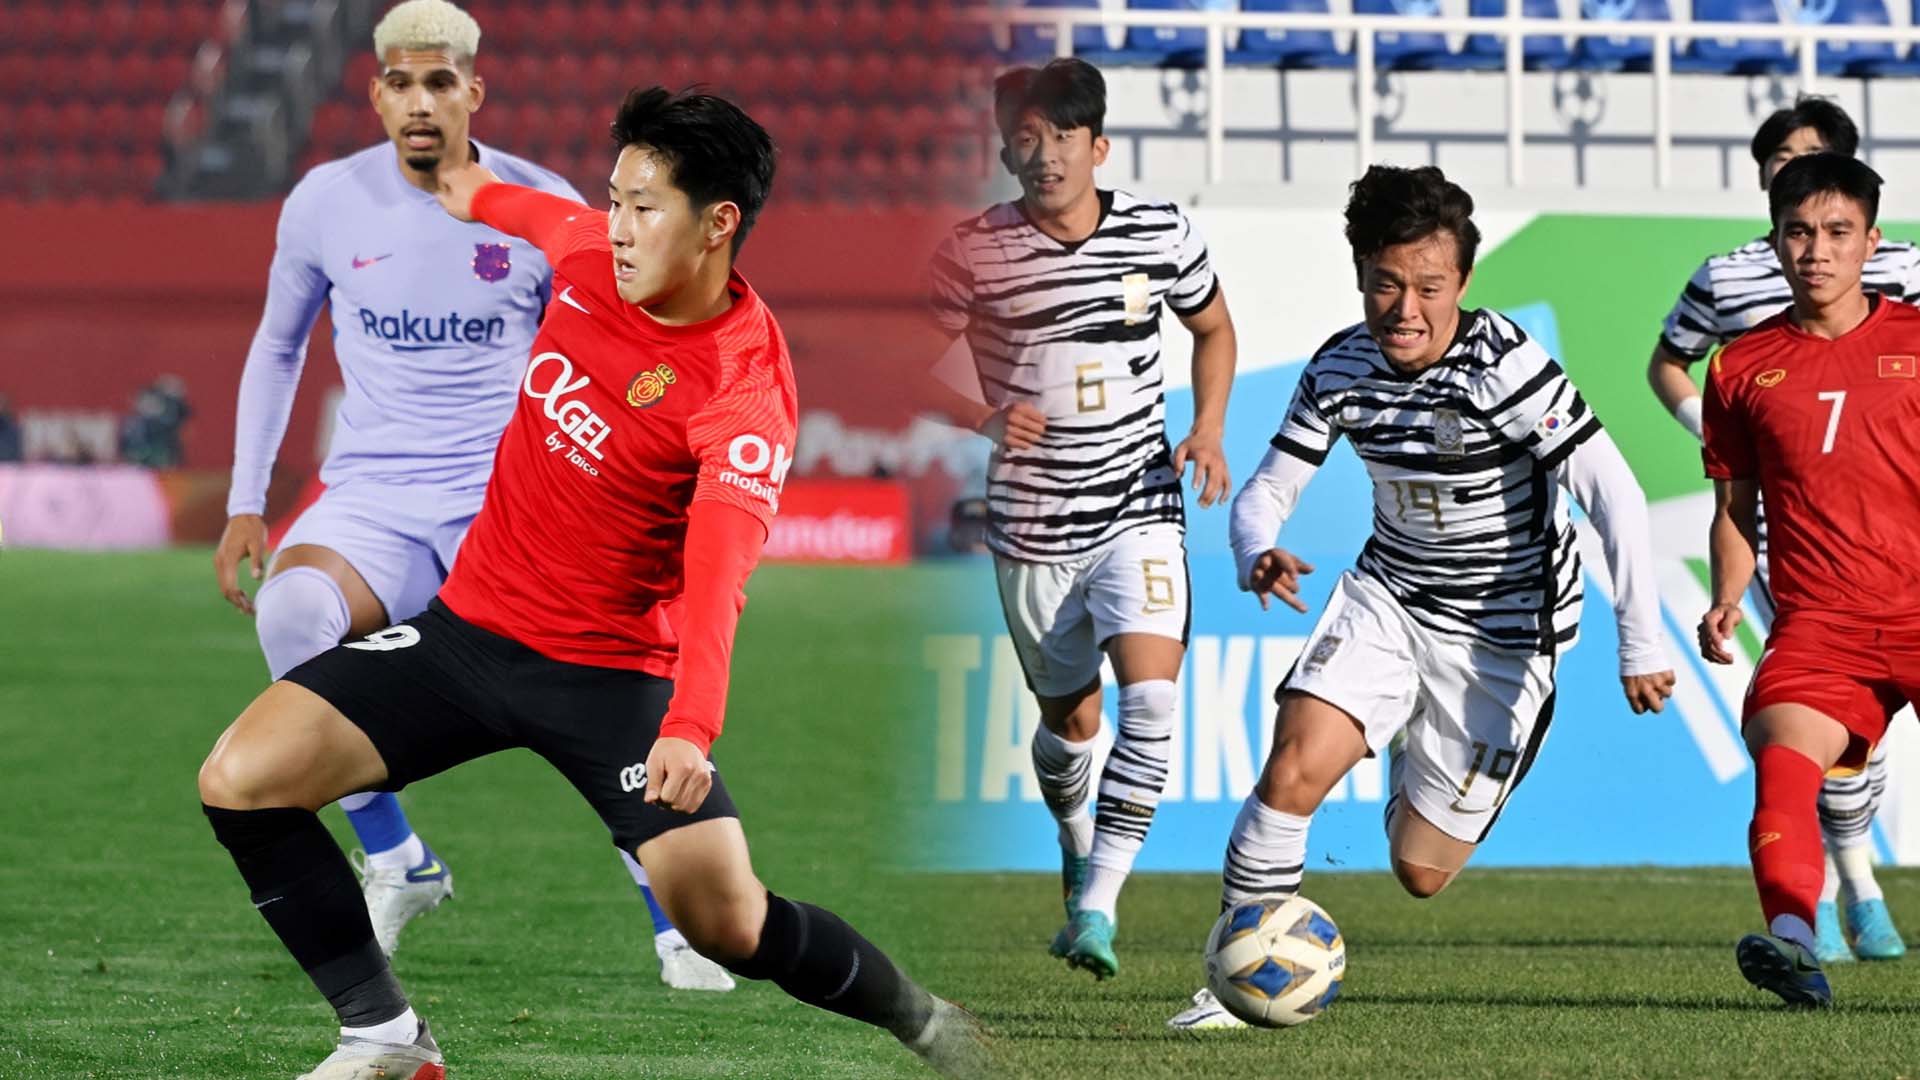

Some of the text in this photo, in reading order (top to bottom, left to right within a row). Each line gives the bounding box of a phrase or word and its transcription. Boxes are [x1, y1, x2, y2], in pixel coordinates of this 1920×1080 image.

[359, 307, 505, 343] Rakuten
[1076, 362, 1106, 414] 6
[1818, 391, 1847, 454] 7
[545, 431, 600, 476] by Taica
[1388, 480, 1445, 530] 19
[1141, 558, 1175, 605] 6
